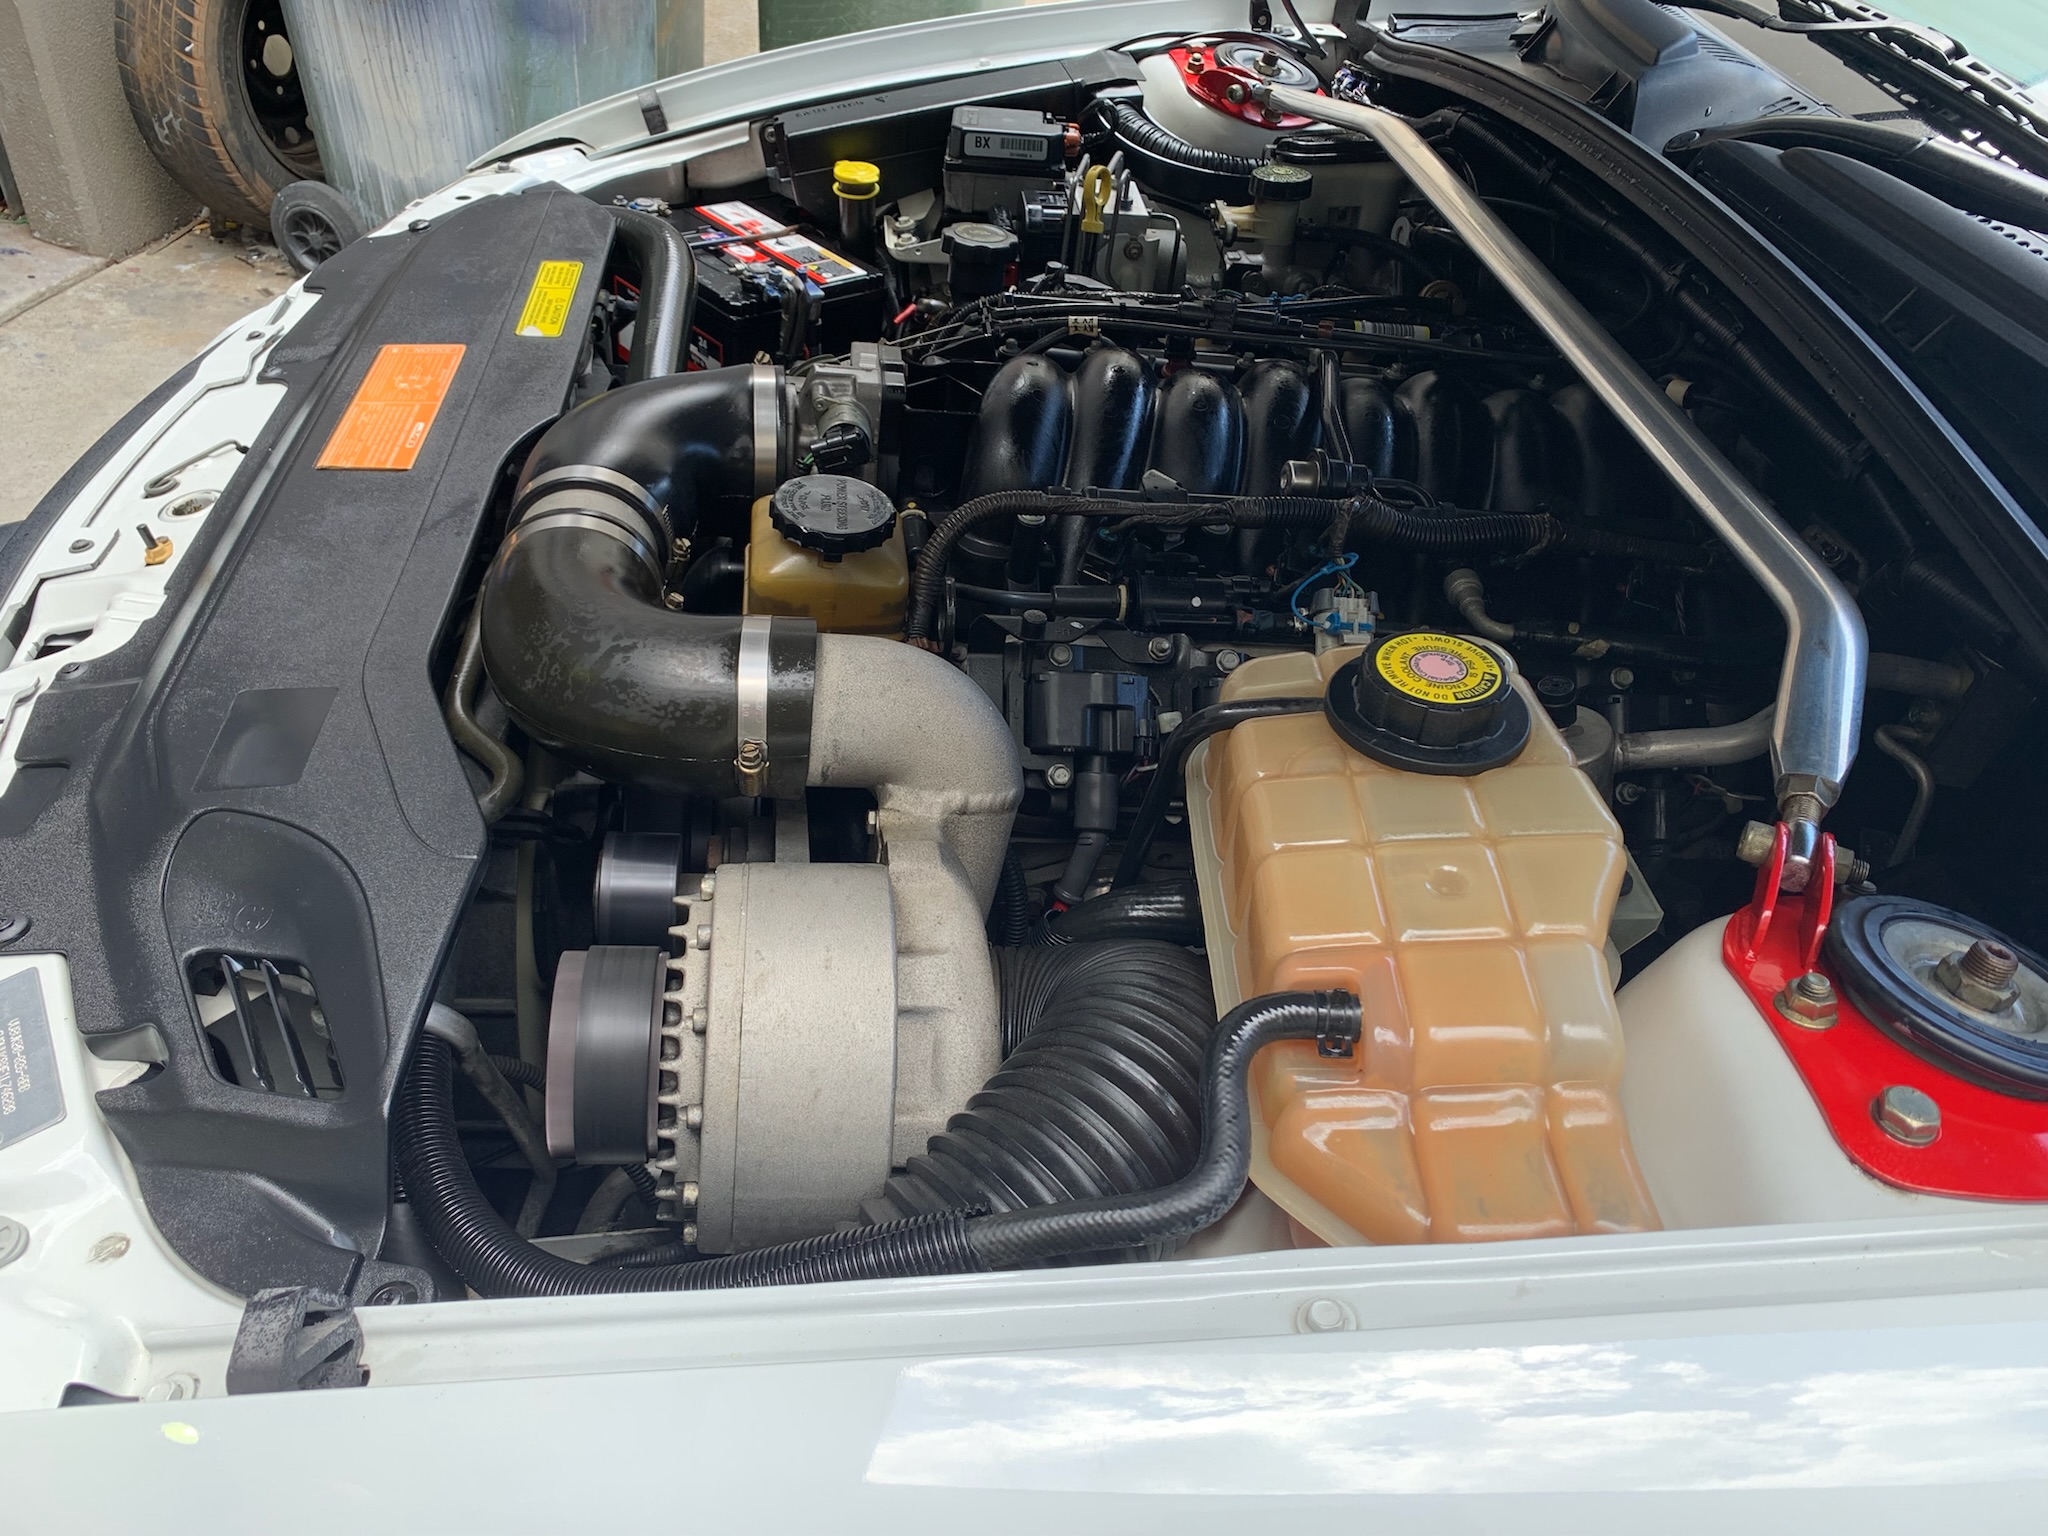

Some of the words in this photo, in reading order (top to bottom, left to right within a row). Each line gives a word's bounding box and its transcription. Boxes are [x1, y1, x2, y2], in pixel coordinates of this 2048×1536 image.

[975, 136, 991, 149] BX
[836, 479, 848, 500] POWER
[836, 501, 848, 530] STEERING
[1396, 636, 1413, 647] HOT
[1423, 636, 1464, 647] SLOWLY
[1382, 644, 1397, 661] WHEN
[1411, 646, 1468, 660] PRESSURE
[1465, 646, 1495, 669] REMOVE
[1399, 652, 1422, 682] COOLANT
[1464, 659, 1478, 671] PSI
[1381, 662, 1408, 687] REMOVE
[1428, 674, 1460, 682] Special
[1409, 686, 1430, 697] NOT
[1425, 680, 1468, 690] ENGINE
[1455, 681, 1492, 698] CAUTION
